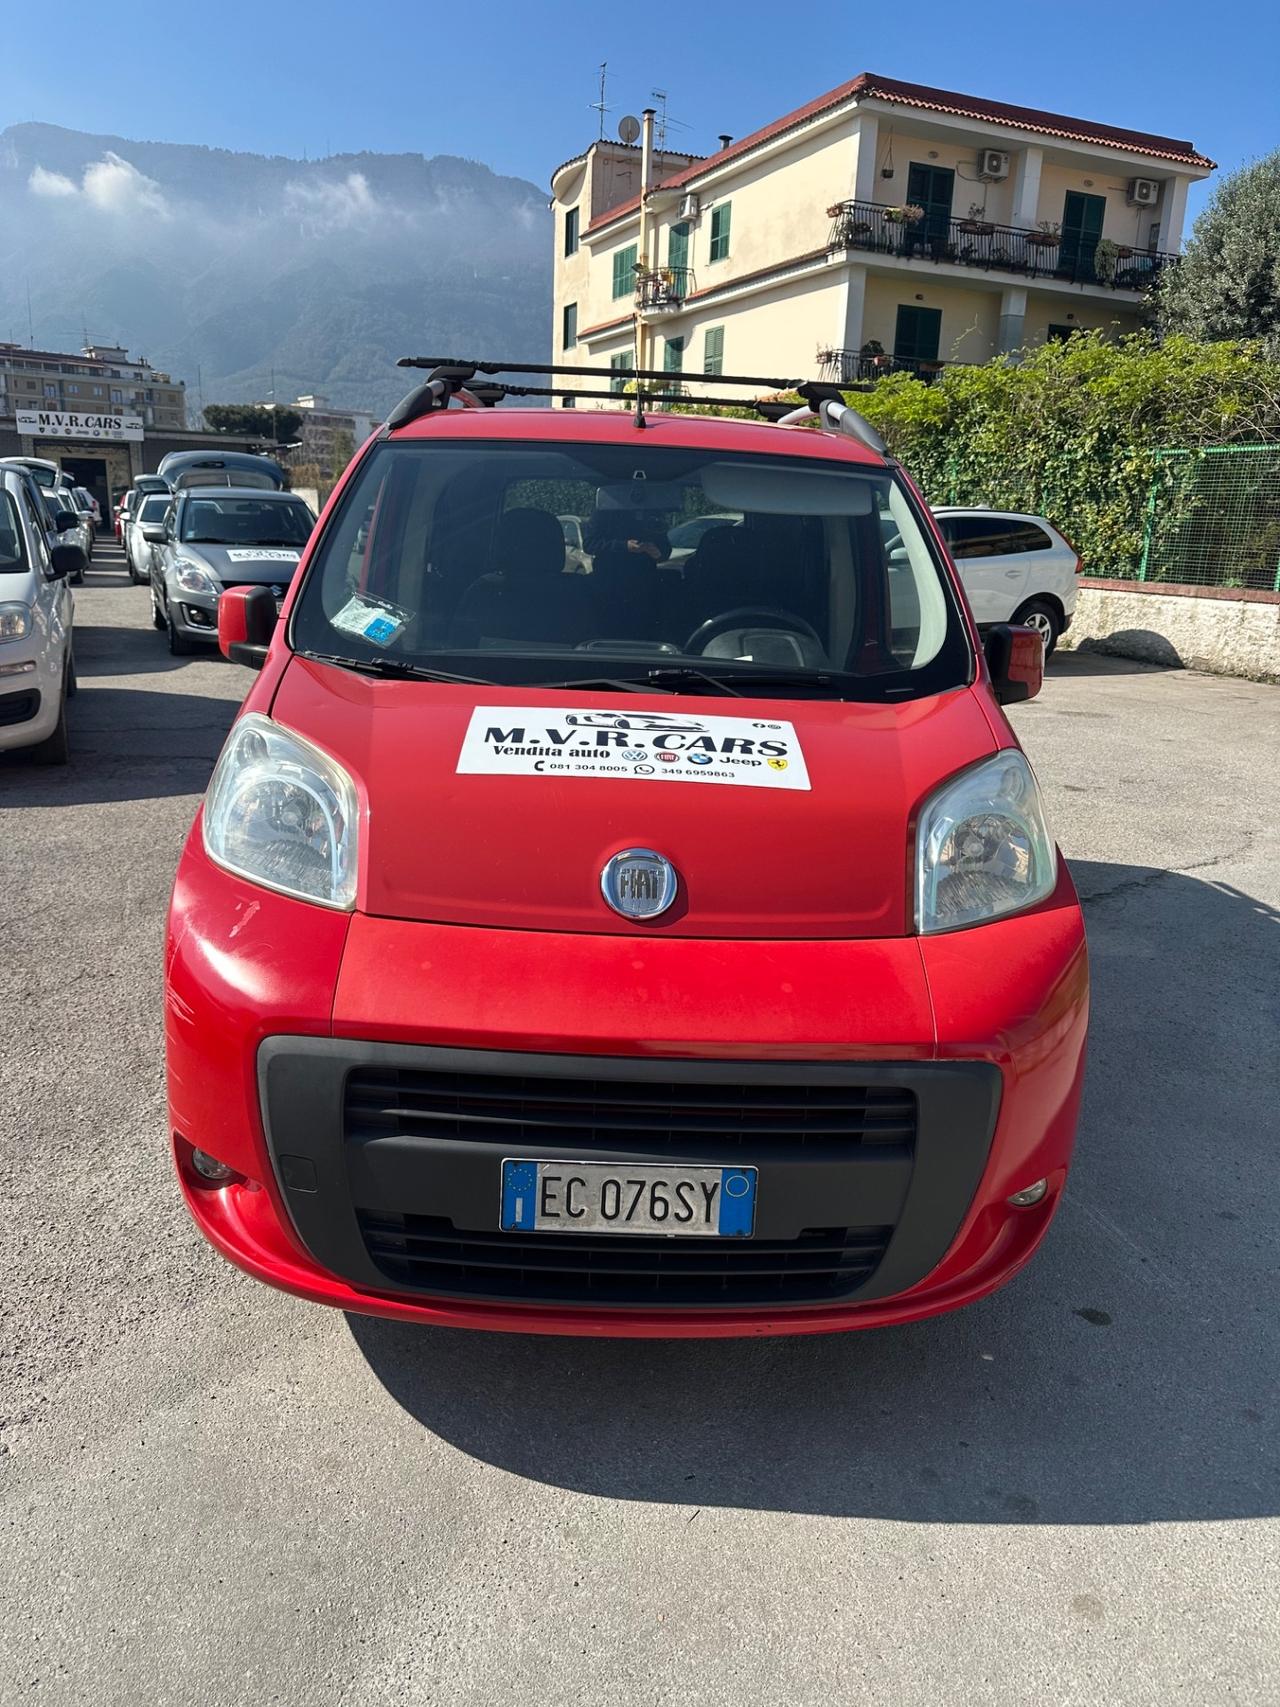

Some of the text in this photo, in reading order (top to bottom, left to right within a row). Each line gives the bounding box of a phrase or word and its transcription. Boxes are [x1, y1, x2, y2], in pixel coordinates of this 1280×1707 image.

[39, 414, 122, 429] M.V.R.CARS
[493, 745, 611, 760] Vendita auto
[550, 763, 628, 773] 081 304 8005
[719, 757, 762, 767] Jeep
[661, 768, 683, 776] 349
[620, 868, 665, 899] FIAT
[540, 1176, 720, 1223] EC 076SY
